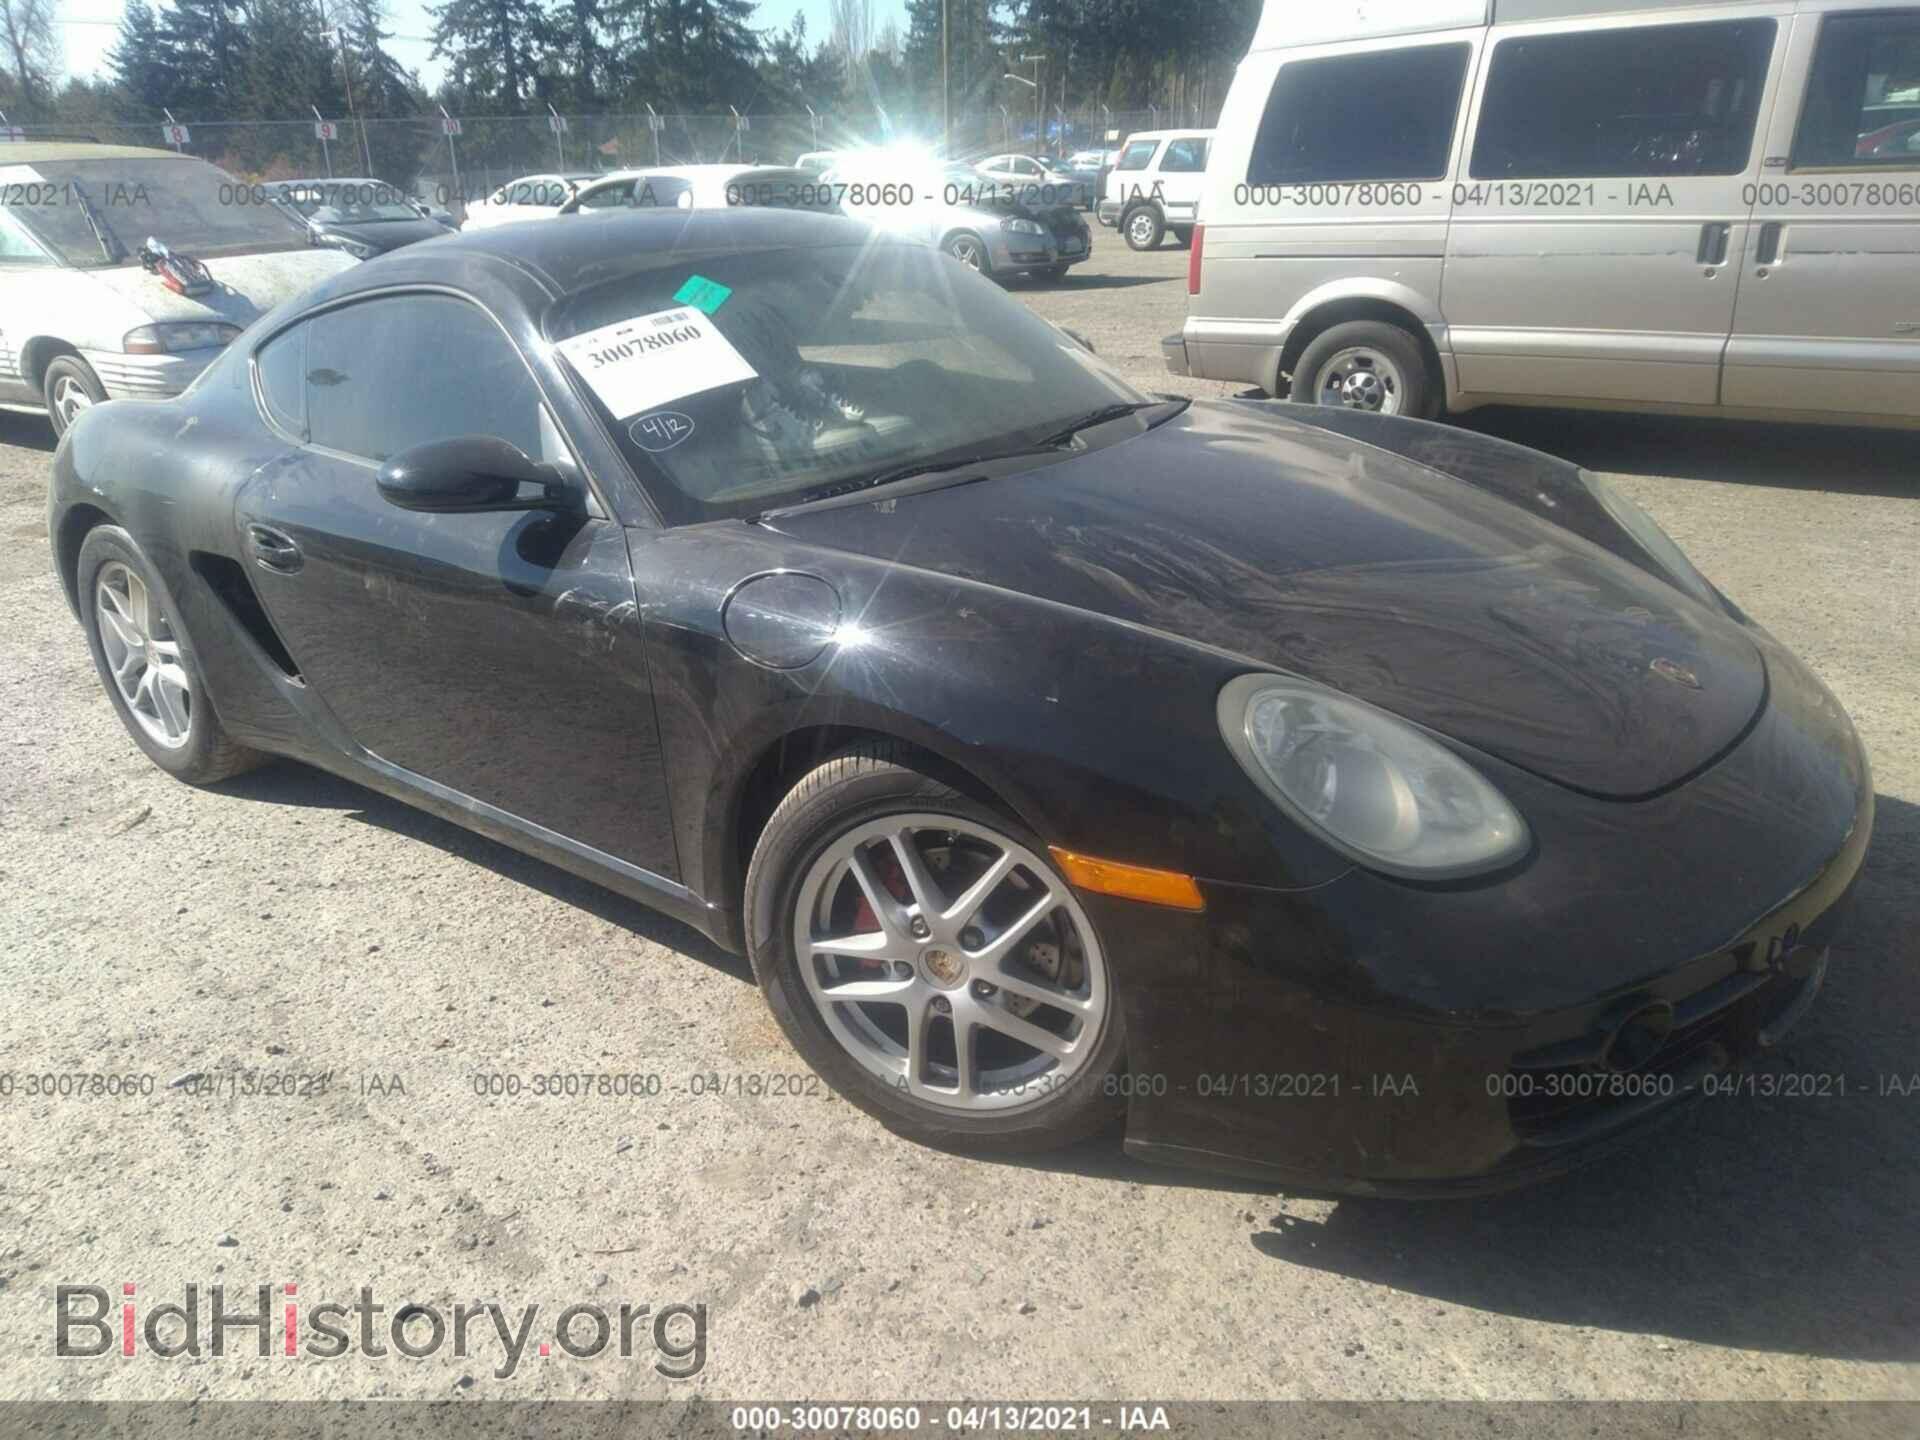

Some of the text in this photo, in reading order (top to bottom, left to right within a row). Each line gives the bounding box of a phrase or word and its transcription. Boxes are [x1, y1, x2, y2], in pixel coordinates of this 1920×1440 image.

[171, 126, 182, 143] 8
[320, 123, 331, 138] 9
[588, 324, 702, 369] 30078060
[642, 416, 688, 441] 4/12
